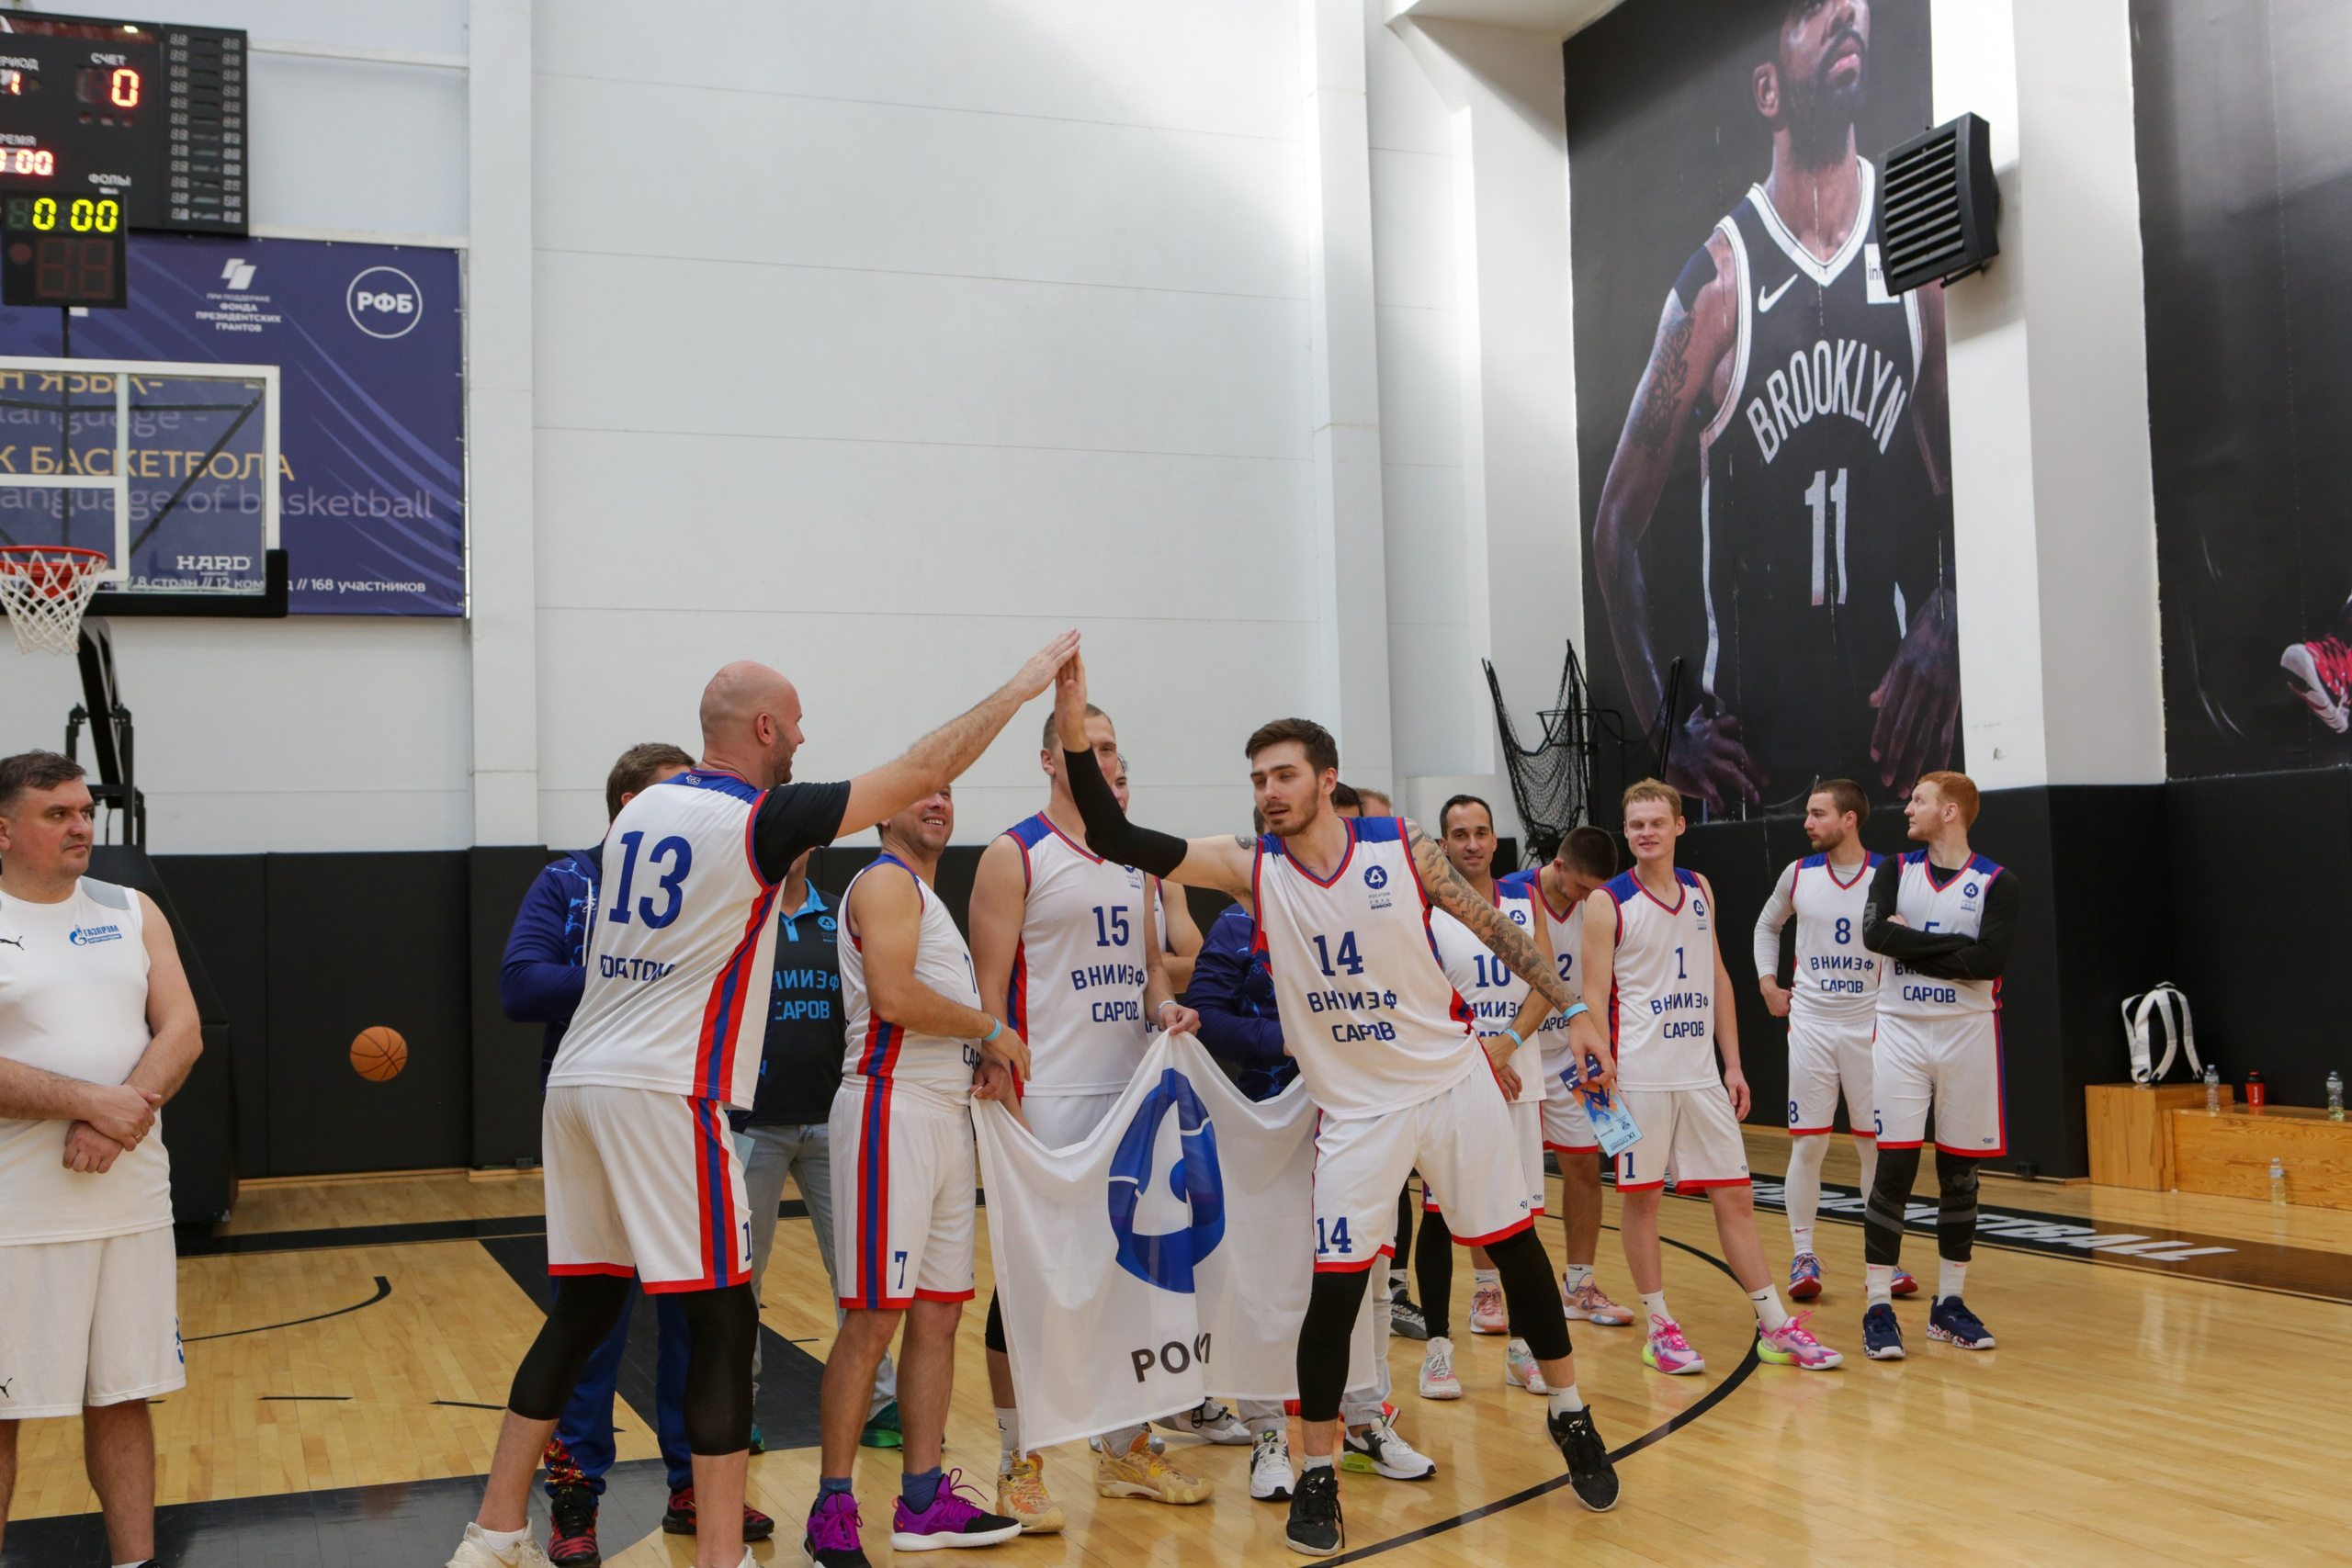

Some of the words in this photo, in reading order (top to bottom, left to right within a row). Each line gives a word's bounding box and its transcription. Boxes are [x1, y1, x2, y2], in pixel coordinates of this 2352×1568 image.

[0, 56, 40, 72] РИОД
[90, 52, 127, 66] СЧЕТ
[111, 69, 140, 107] 0
[88, 173, 131, 186] ФОЛЫ
[220, 301, 258, 312] ФОНДА
[357, 291, 413, 314] РФБ
[195, 310, 282, 323] ПРЕЗИДЕНТСКИХ
[215, 321, 263, 333] ГРАНТОВ
[1747, 339, 1906, 464] BROOKLYN
[187, 484, 232, 513] of
[239, 485, 434, 519] bsketball
[1804, 468, 1848, 606] 11
[176, 556, 251, 570] HARD
[311, 578, 334, 592] 168
[337, 579, 426, 593] участников
[608, 830, 692, 929] 13
[1092, 906, 1129, 947] 15
[1835, 918, 1851, 944] 8
[1313, 931, 1364, 976] 14
[1674, 946, 1687, 979] 1
[1810, 955, 1874, 972] ВНИИЭФ
[1071, 964, 1146, 991] ВНИИЭФ
[1474, 953, 1511, 987] 10
[1821, 978, 1864, 994] САРОВ
[1903, 985, 1957, 1004] САРОВ
[1091, 1000, 1140, 1023] САРОВ
[1650, 992, 1709, 1015] ВНИИЭФ
[1664, 1021, 1705, 1039] САРОВ
[1789, 1100, 1799, 1123] 8
[1874, 1110, 1883, 1136] 5
[1624, 1151, 1635, 1179] 1
[1317, 1217, 1352, 1254] 14
[894, 1251, 908, 1289] 7
